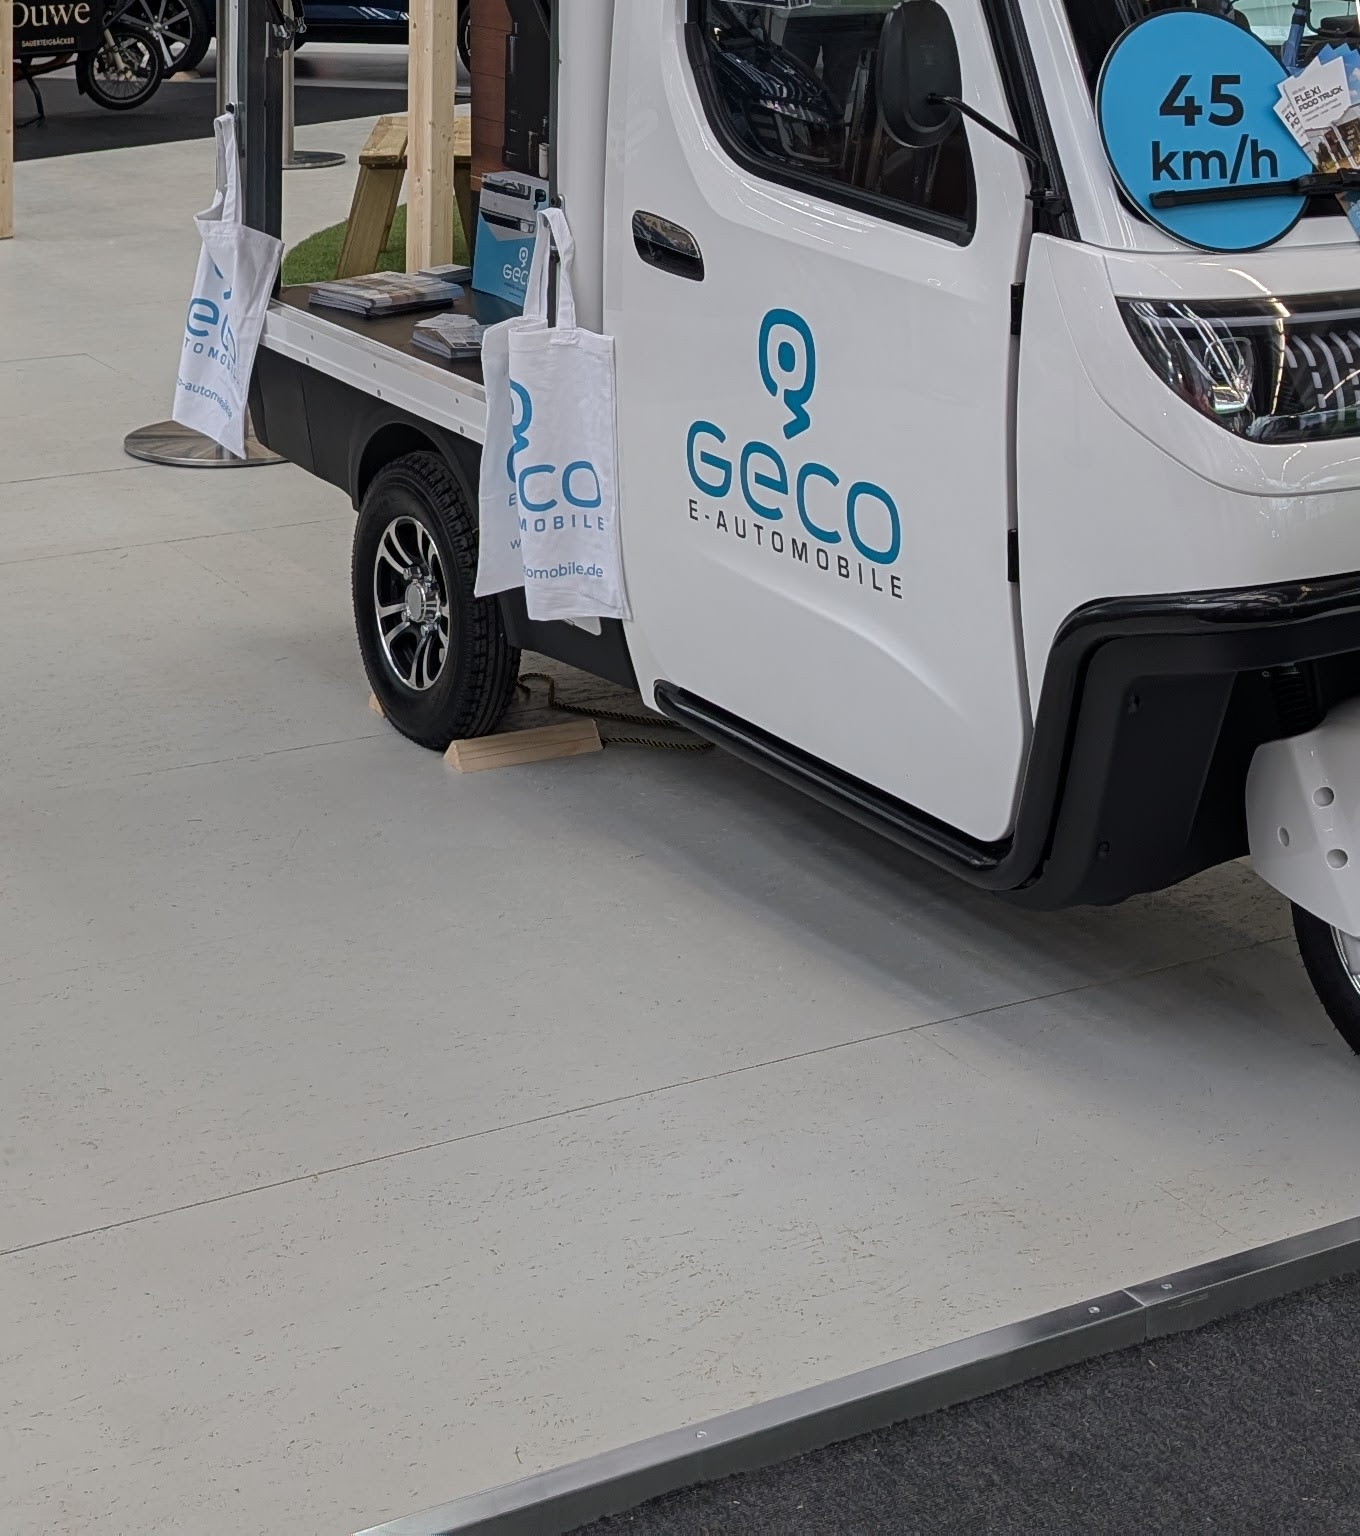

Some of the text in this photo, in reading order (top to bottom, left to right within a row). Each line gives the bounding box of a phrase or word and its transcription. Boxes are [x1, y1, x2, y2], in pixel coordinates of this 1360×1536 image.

[1159, 74, 1244, 127] 45
[1294, 85, 1322, 104] FLEXI
[1298, 97, 1319, 112] FOOD
[1151, 134, 1279, 182] km/h
[687, 498, 904, 600] E-AUTOMOBILE
